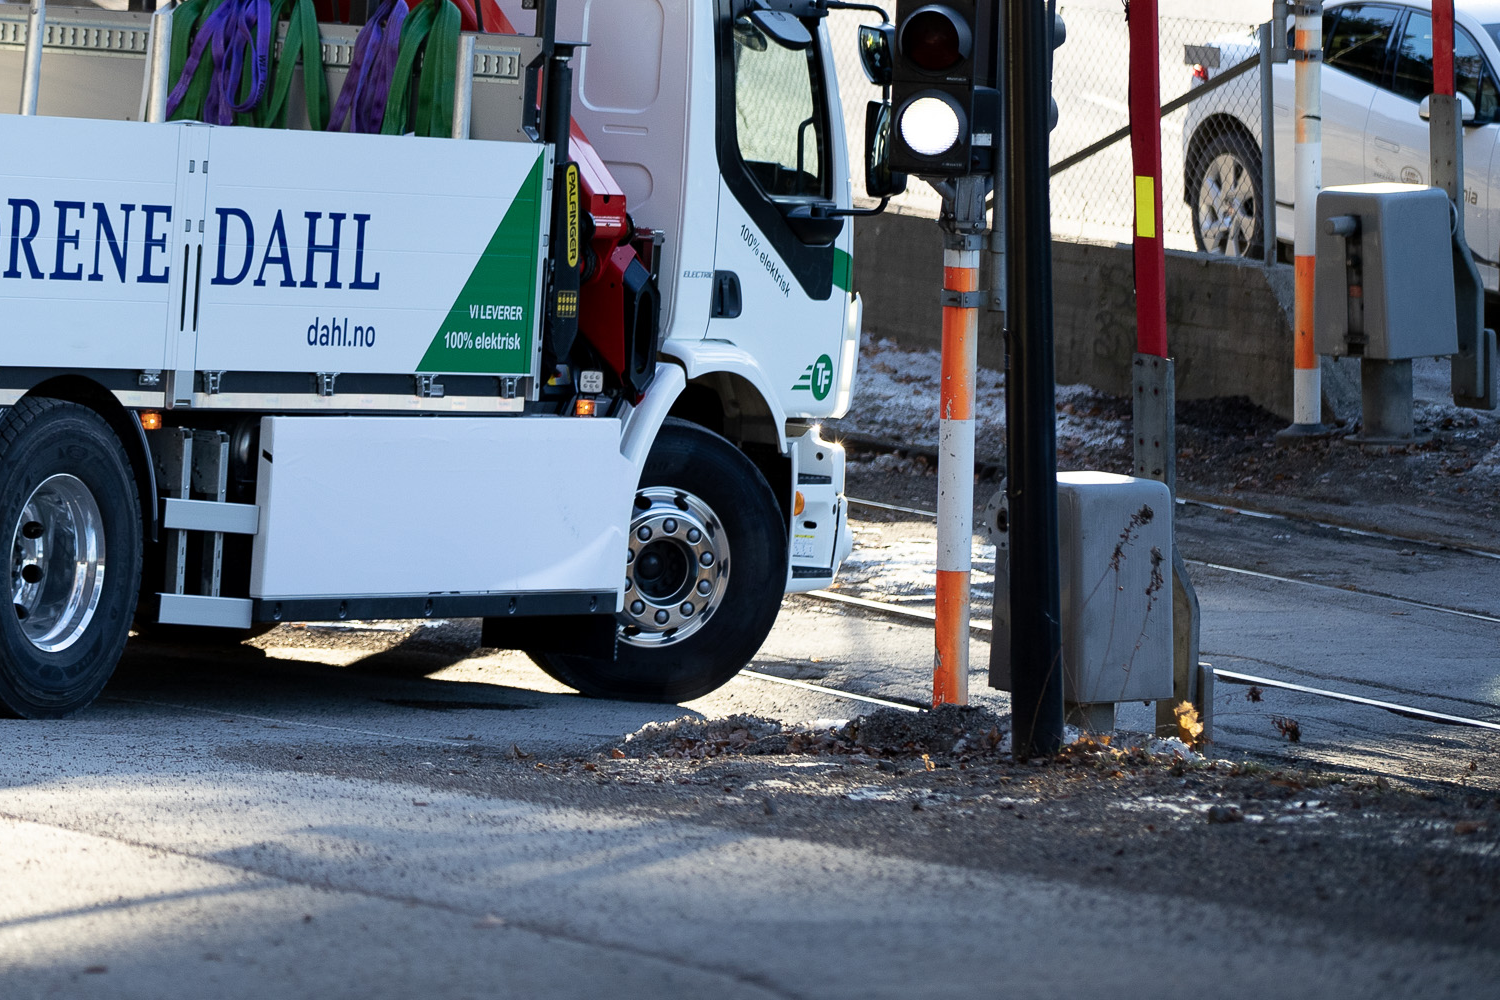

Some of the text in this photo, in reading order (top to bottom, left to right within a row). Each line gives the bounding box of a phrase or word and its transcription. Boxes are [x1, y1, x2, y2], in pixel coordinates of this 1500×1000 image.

[568, 171, 577, 261] PALFINGER
[210, 207, 381, 291] DAHL
[740, 223, 791, 298] 100% elektrisk
[469, 304, 523, 321] VI LEVERER
[307, 316, 376, 348] dahl.no
[444, 331, 521, 350] 100% elektrisk
[816, 362, 831, 394] TF
